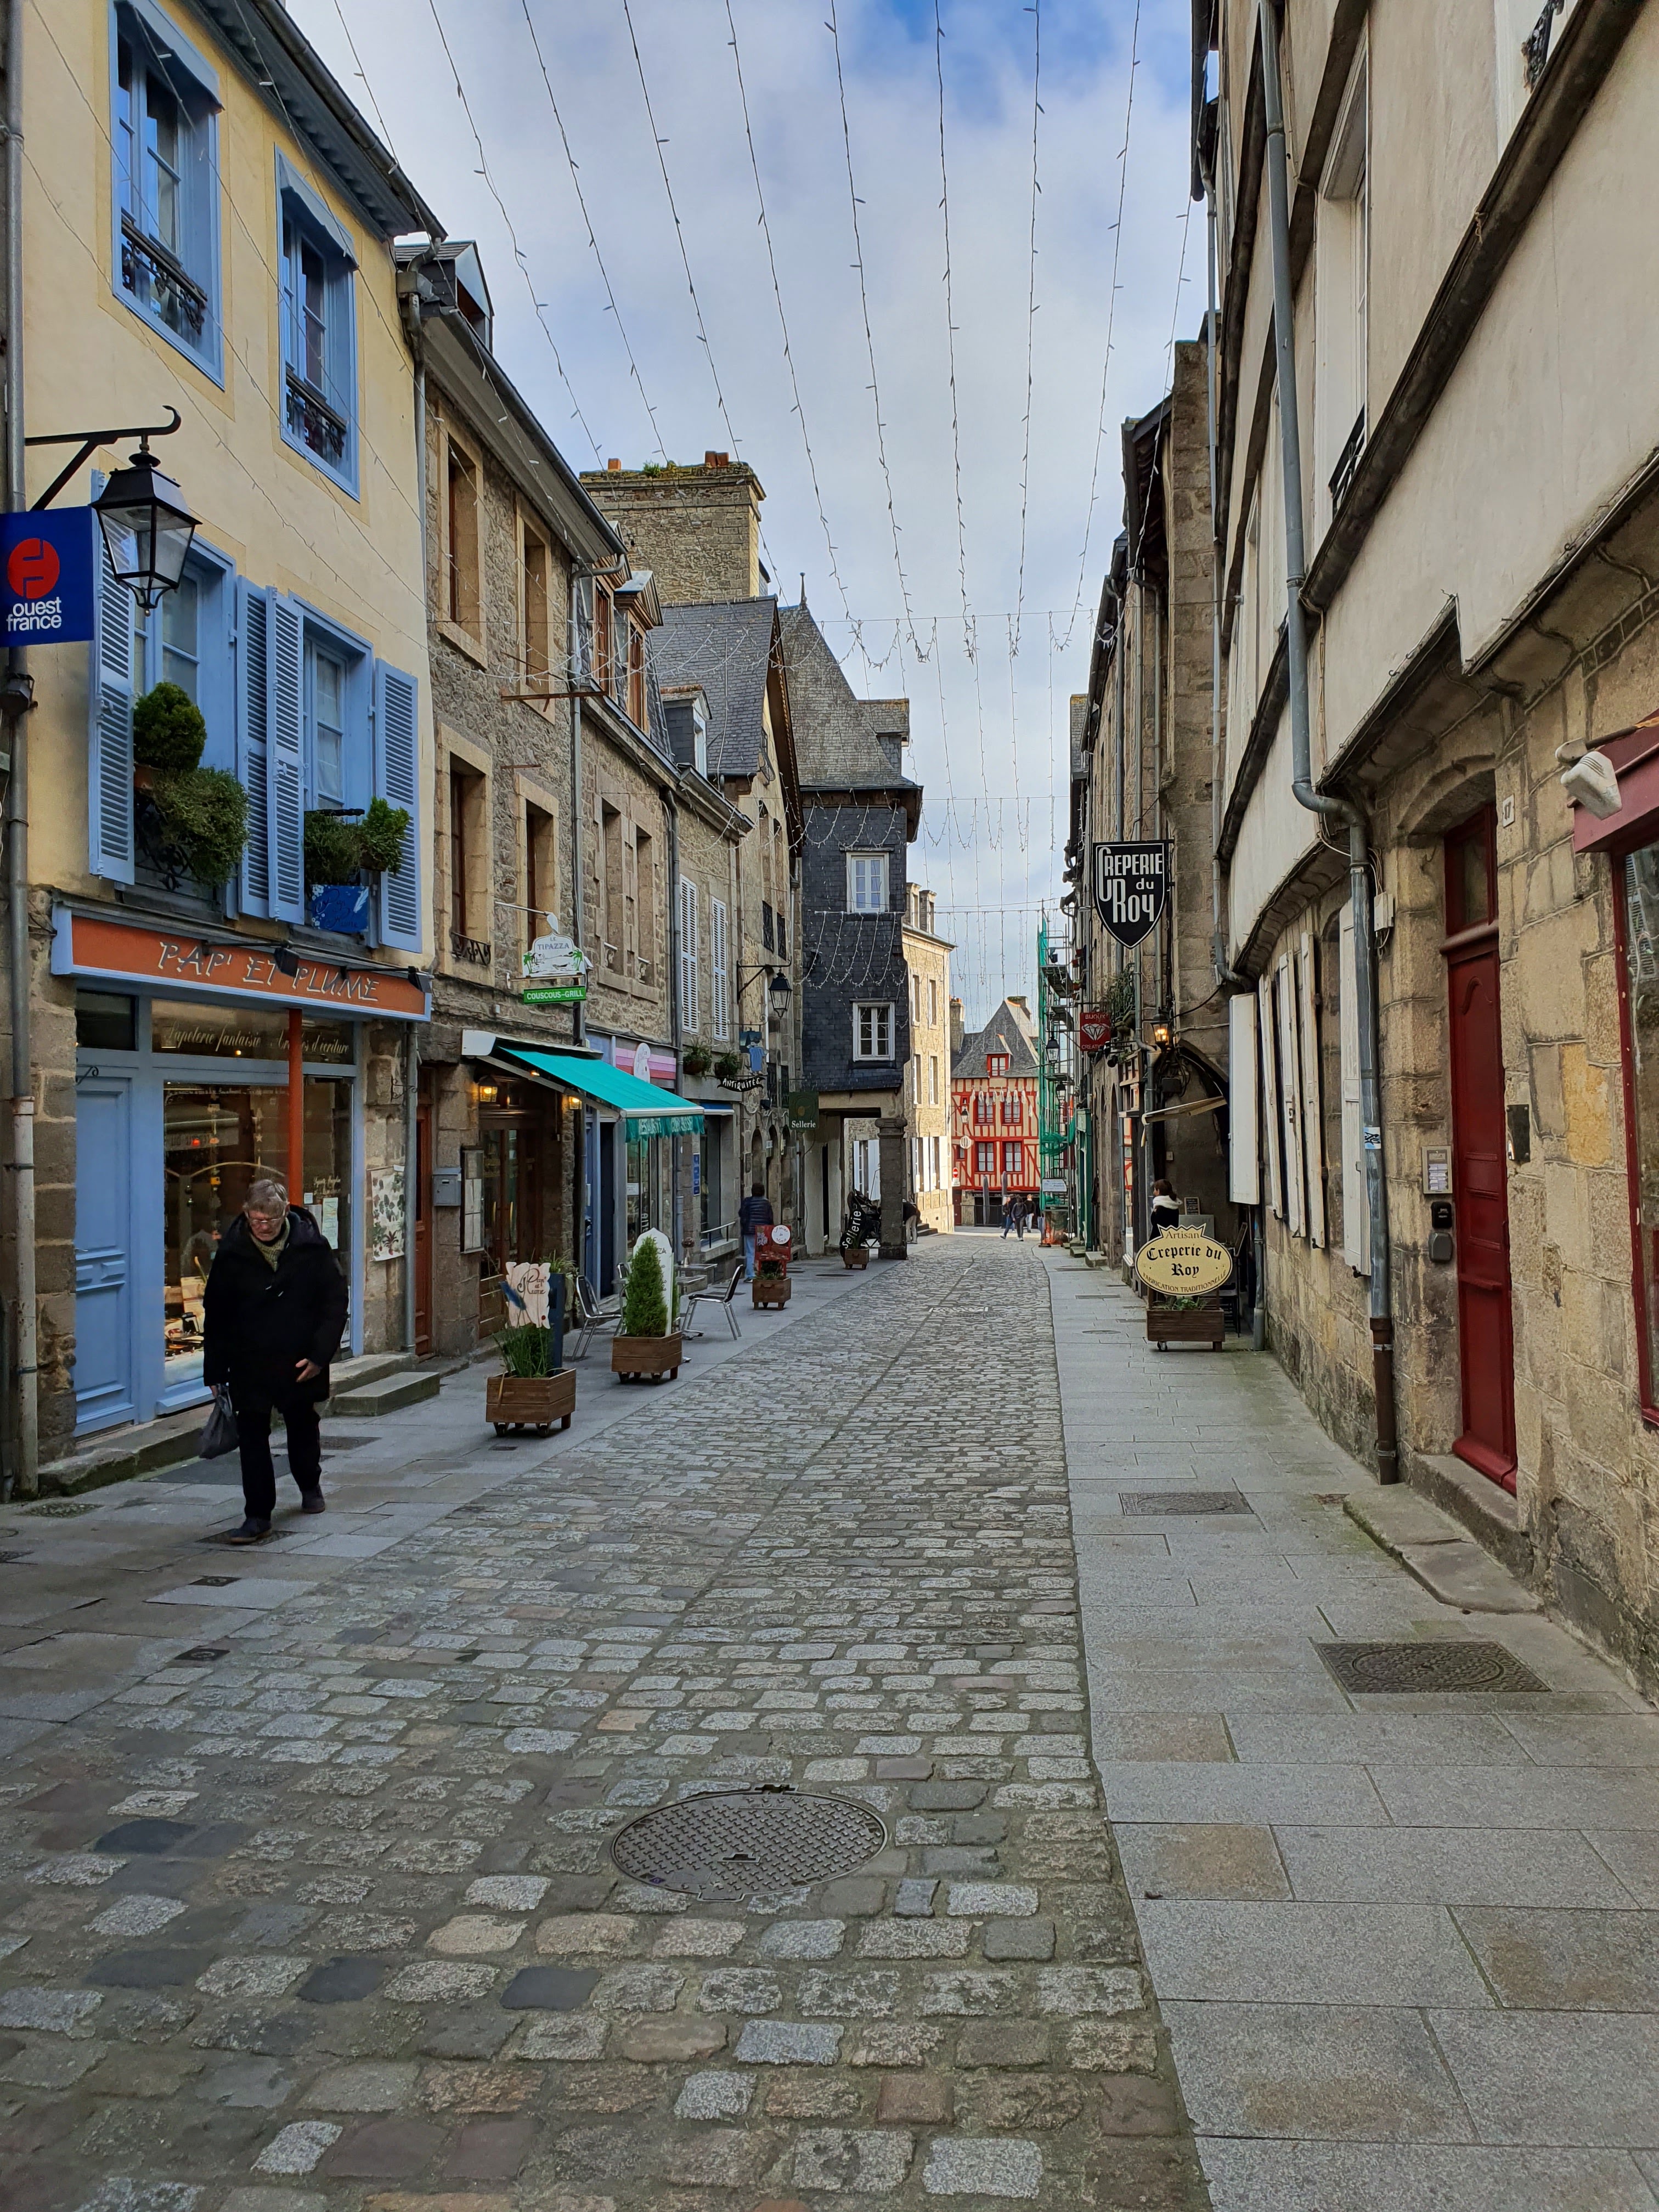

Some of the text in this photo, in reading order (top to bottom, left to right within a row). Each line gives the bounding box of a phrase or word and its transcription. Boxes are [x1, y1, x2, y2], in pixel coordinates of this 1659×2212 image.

[13, 596, 62, 617] ouest
[5, 614, 62, 632] france
[1098, 847, 1163, 902] CREPERIE
[1136, 878, 1154, 890] du
[537, 943, 570, 951] TIPAZZA
[292, 967, 381, 1002] PLUME
[527, 989, 584, 1000] COUSCOUS-GRILL
[791, 1120, 816, 1128] Sellerie
[842, 1211, 862, 1249] Sellerie
[1166, 1231, 1200, 1239] Artisan
[1147, 1244, 1222, 1261] Creperie du
[1171, 1263, 1199, 1278] Roy
[1143, 1269, 1227, 1293] FABRICATION TRADITIONNELLE
